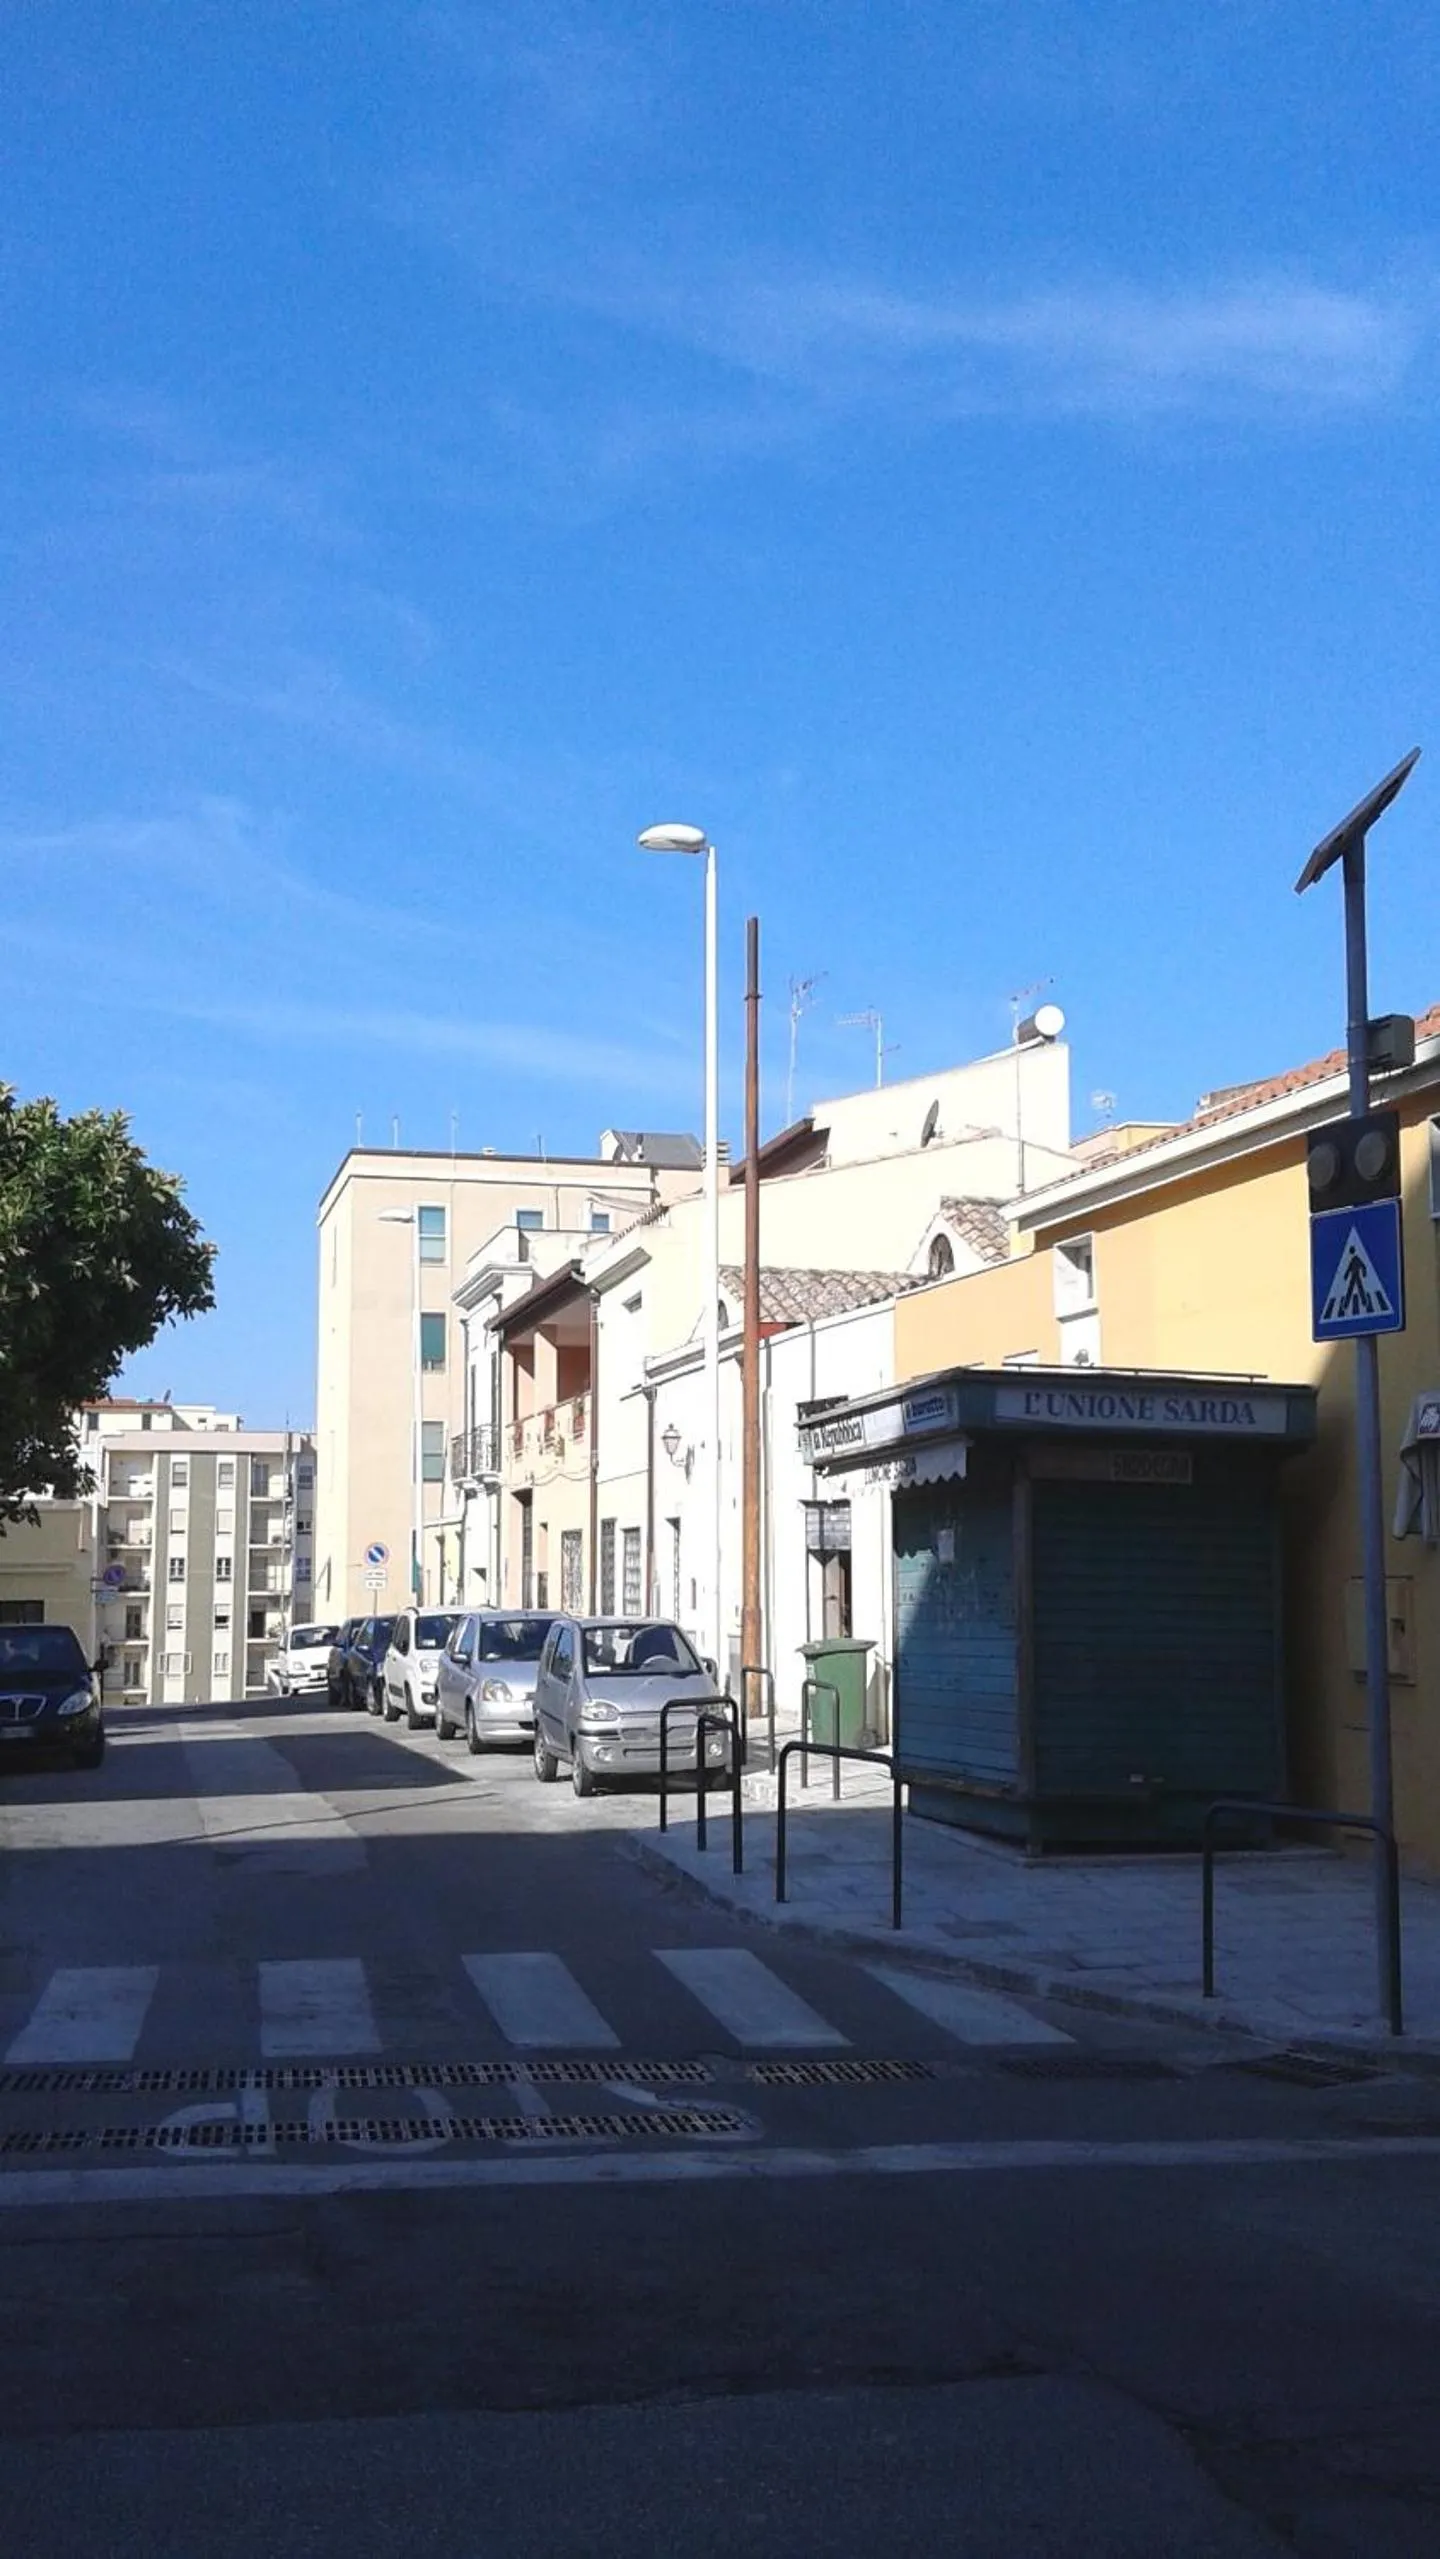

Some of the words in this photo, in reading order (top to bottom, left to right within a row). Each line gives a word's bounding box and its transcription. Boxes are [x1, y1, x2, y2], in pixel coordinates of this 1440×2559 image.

[1023, 1391, 1155, 1421] L'UNIONE
[1163, 1397, 1256, 1425] SARDA
[155, 2070, 766, 2157] STOP
